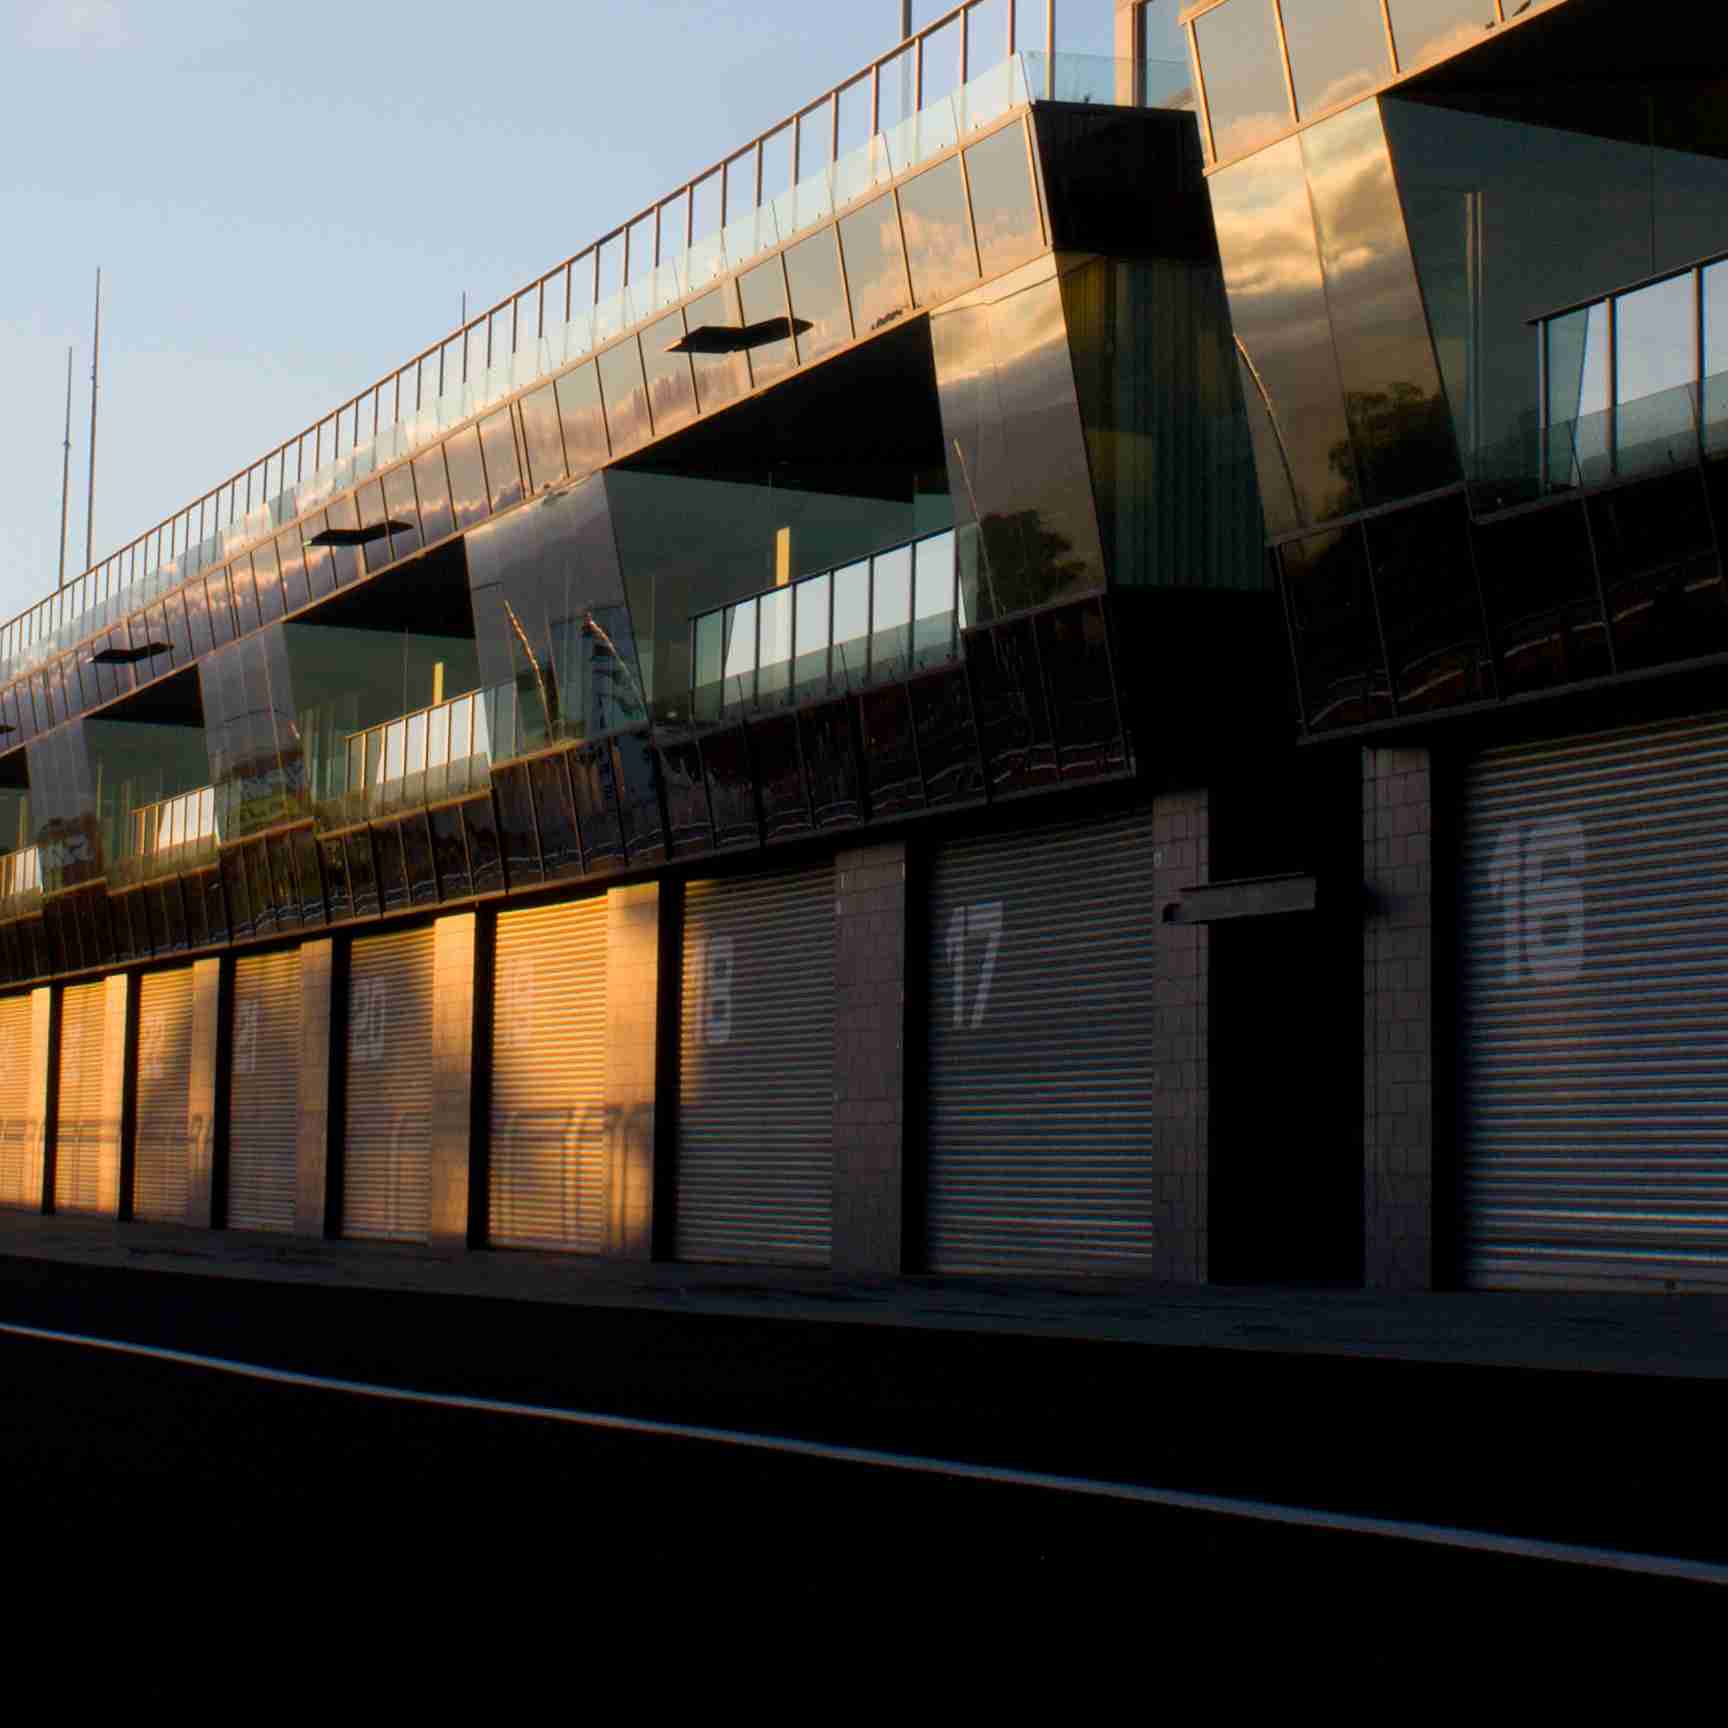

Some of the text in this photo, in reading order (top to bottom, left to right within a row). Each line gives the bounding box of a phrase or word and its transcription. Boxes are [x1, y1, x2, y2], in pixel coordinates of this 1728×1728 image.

[1486, 815, 1587, 985] 16
[349, 974, 386, 1062] 20
[695, 932, 734, 1045] 18
[944, 900, 1004, 1030] 17
